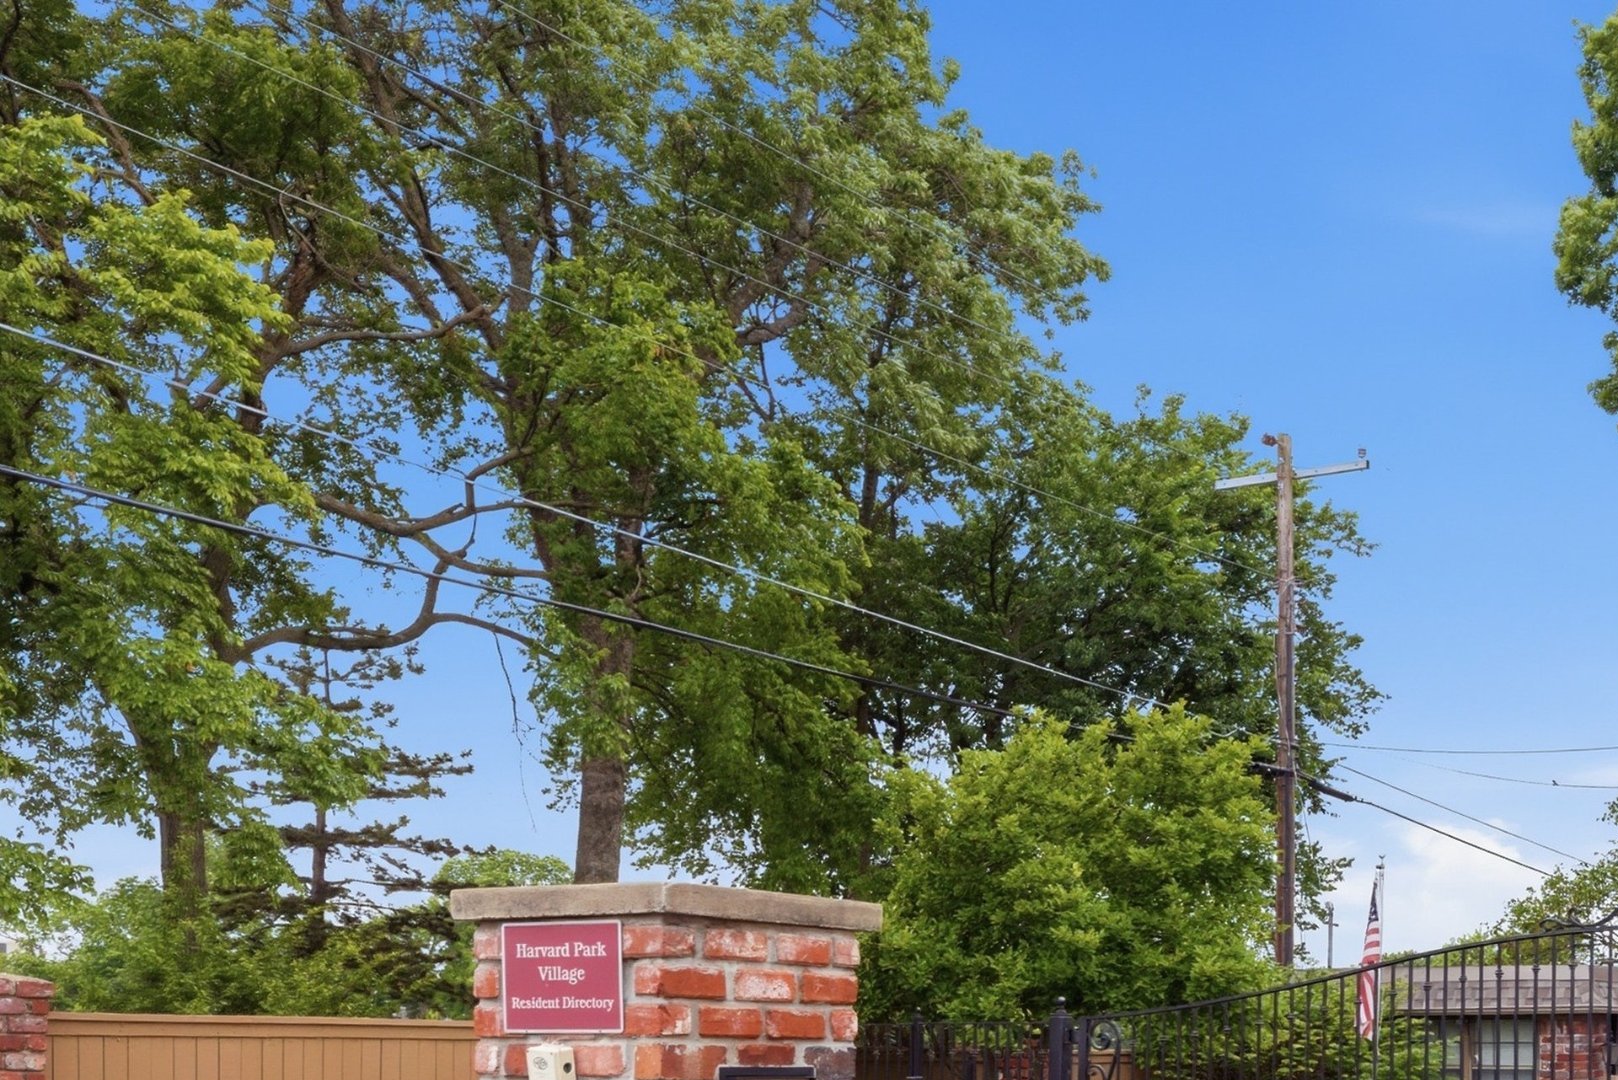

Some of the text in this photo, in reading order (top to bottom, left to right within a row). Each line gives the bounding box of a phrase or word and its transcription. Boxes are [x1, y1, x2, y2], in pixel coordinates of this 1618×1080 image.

[516, 941, 607, 958] Harvard Park
[538, 966, 586, 985] Village
[511, 996, 614, 1012] Resident Directory
